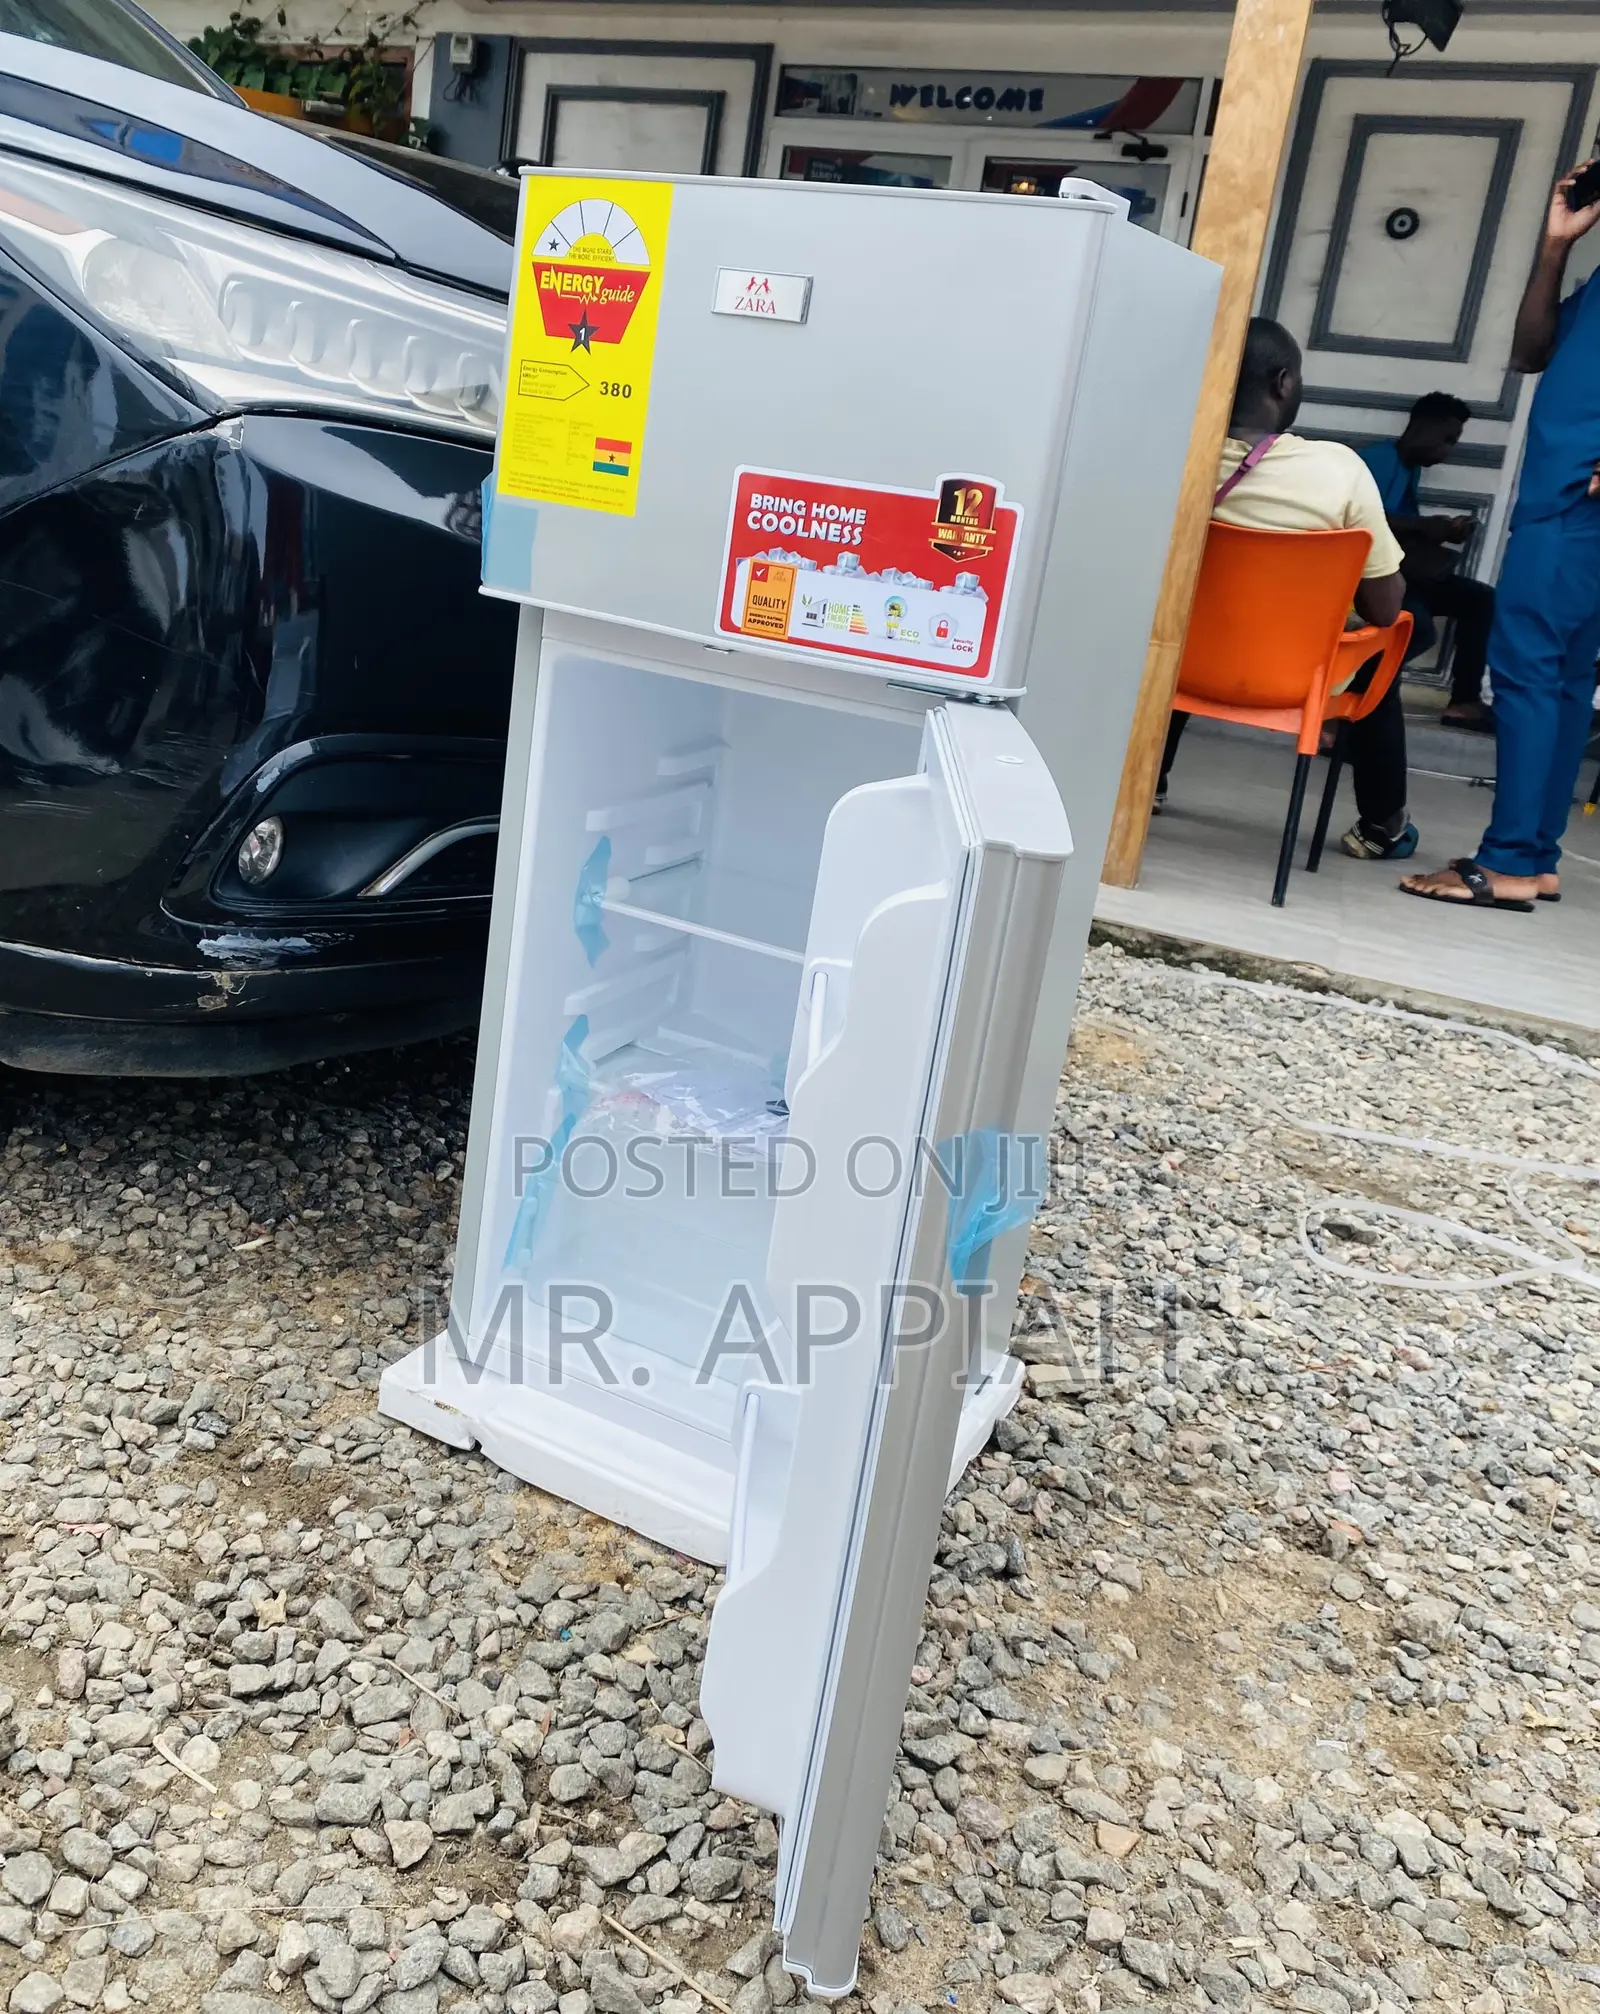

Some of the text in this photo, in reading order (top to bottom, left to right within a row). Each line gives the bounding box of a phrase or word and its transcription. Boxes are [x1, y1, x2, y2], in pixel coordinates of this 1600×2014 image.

[888, 83, 1045, 112] WELCOME
[540, 265, 605, 298] ENERGY
[600, 285, 635, 305] guide
[735, 296, 776, 315] ZARA
[579, 327, 586, 341] 1
[599, 381, 632, 399] 380
[751, 493, 867, 526] BRING HOME
[954, 488, 983, 516] 12
[747, 510, 863, 546] COOLNESS
[950, 514, 979, 526] MONTHS
[752, 595, 787, 610] QUALITY
[828, 602, 852, 616] HOME
[748, 618, 784, 630] APPROVED
[900, 629, 920, 638] ECO
[951, 644, 974, 653] LOCK
